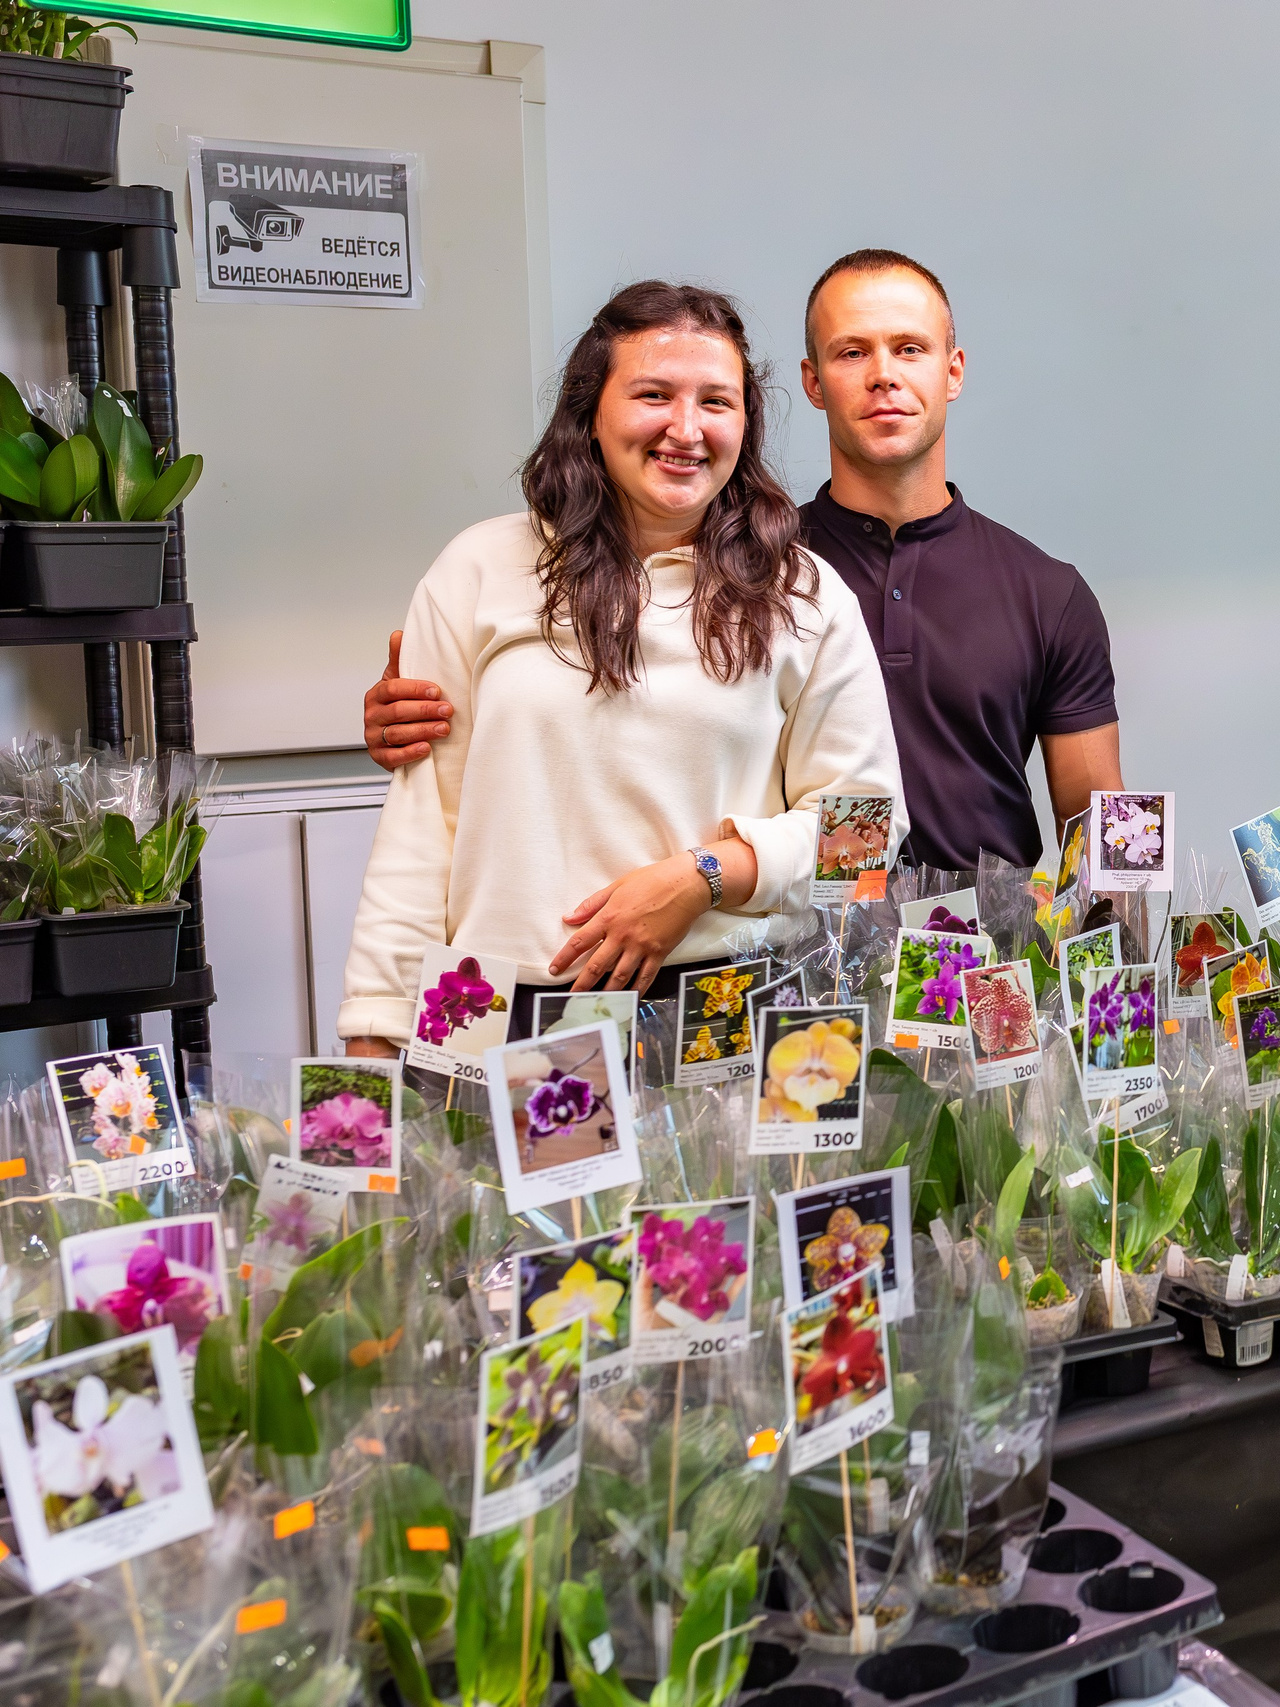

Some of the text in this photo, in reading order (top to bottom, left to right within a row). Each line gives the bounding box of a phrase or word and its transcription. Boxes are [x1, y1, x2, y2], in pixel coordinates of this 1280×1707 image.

[217, 162, 394, 199] ВНИМАНИЕ
[321, 235, 400, 258] ВЕДЁТСЯ
[217, 264, 403, 290] ВИДЕОНАБЛЮДЕНИЕ
